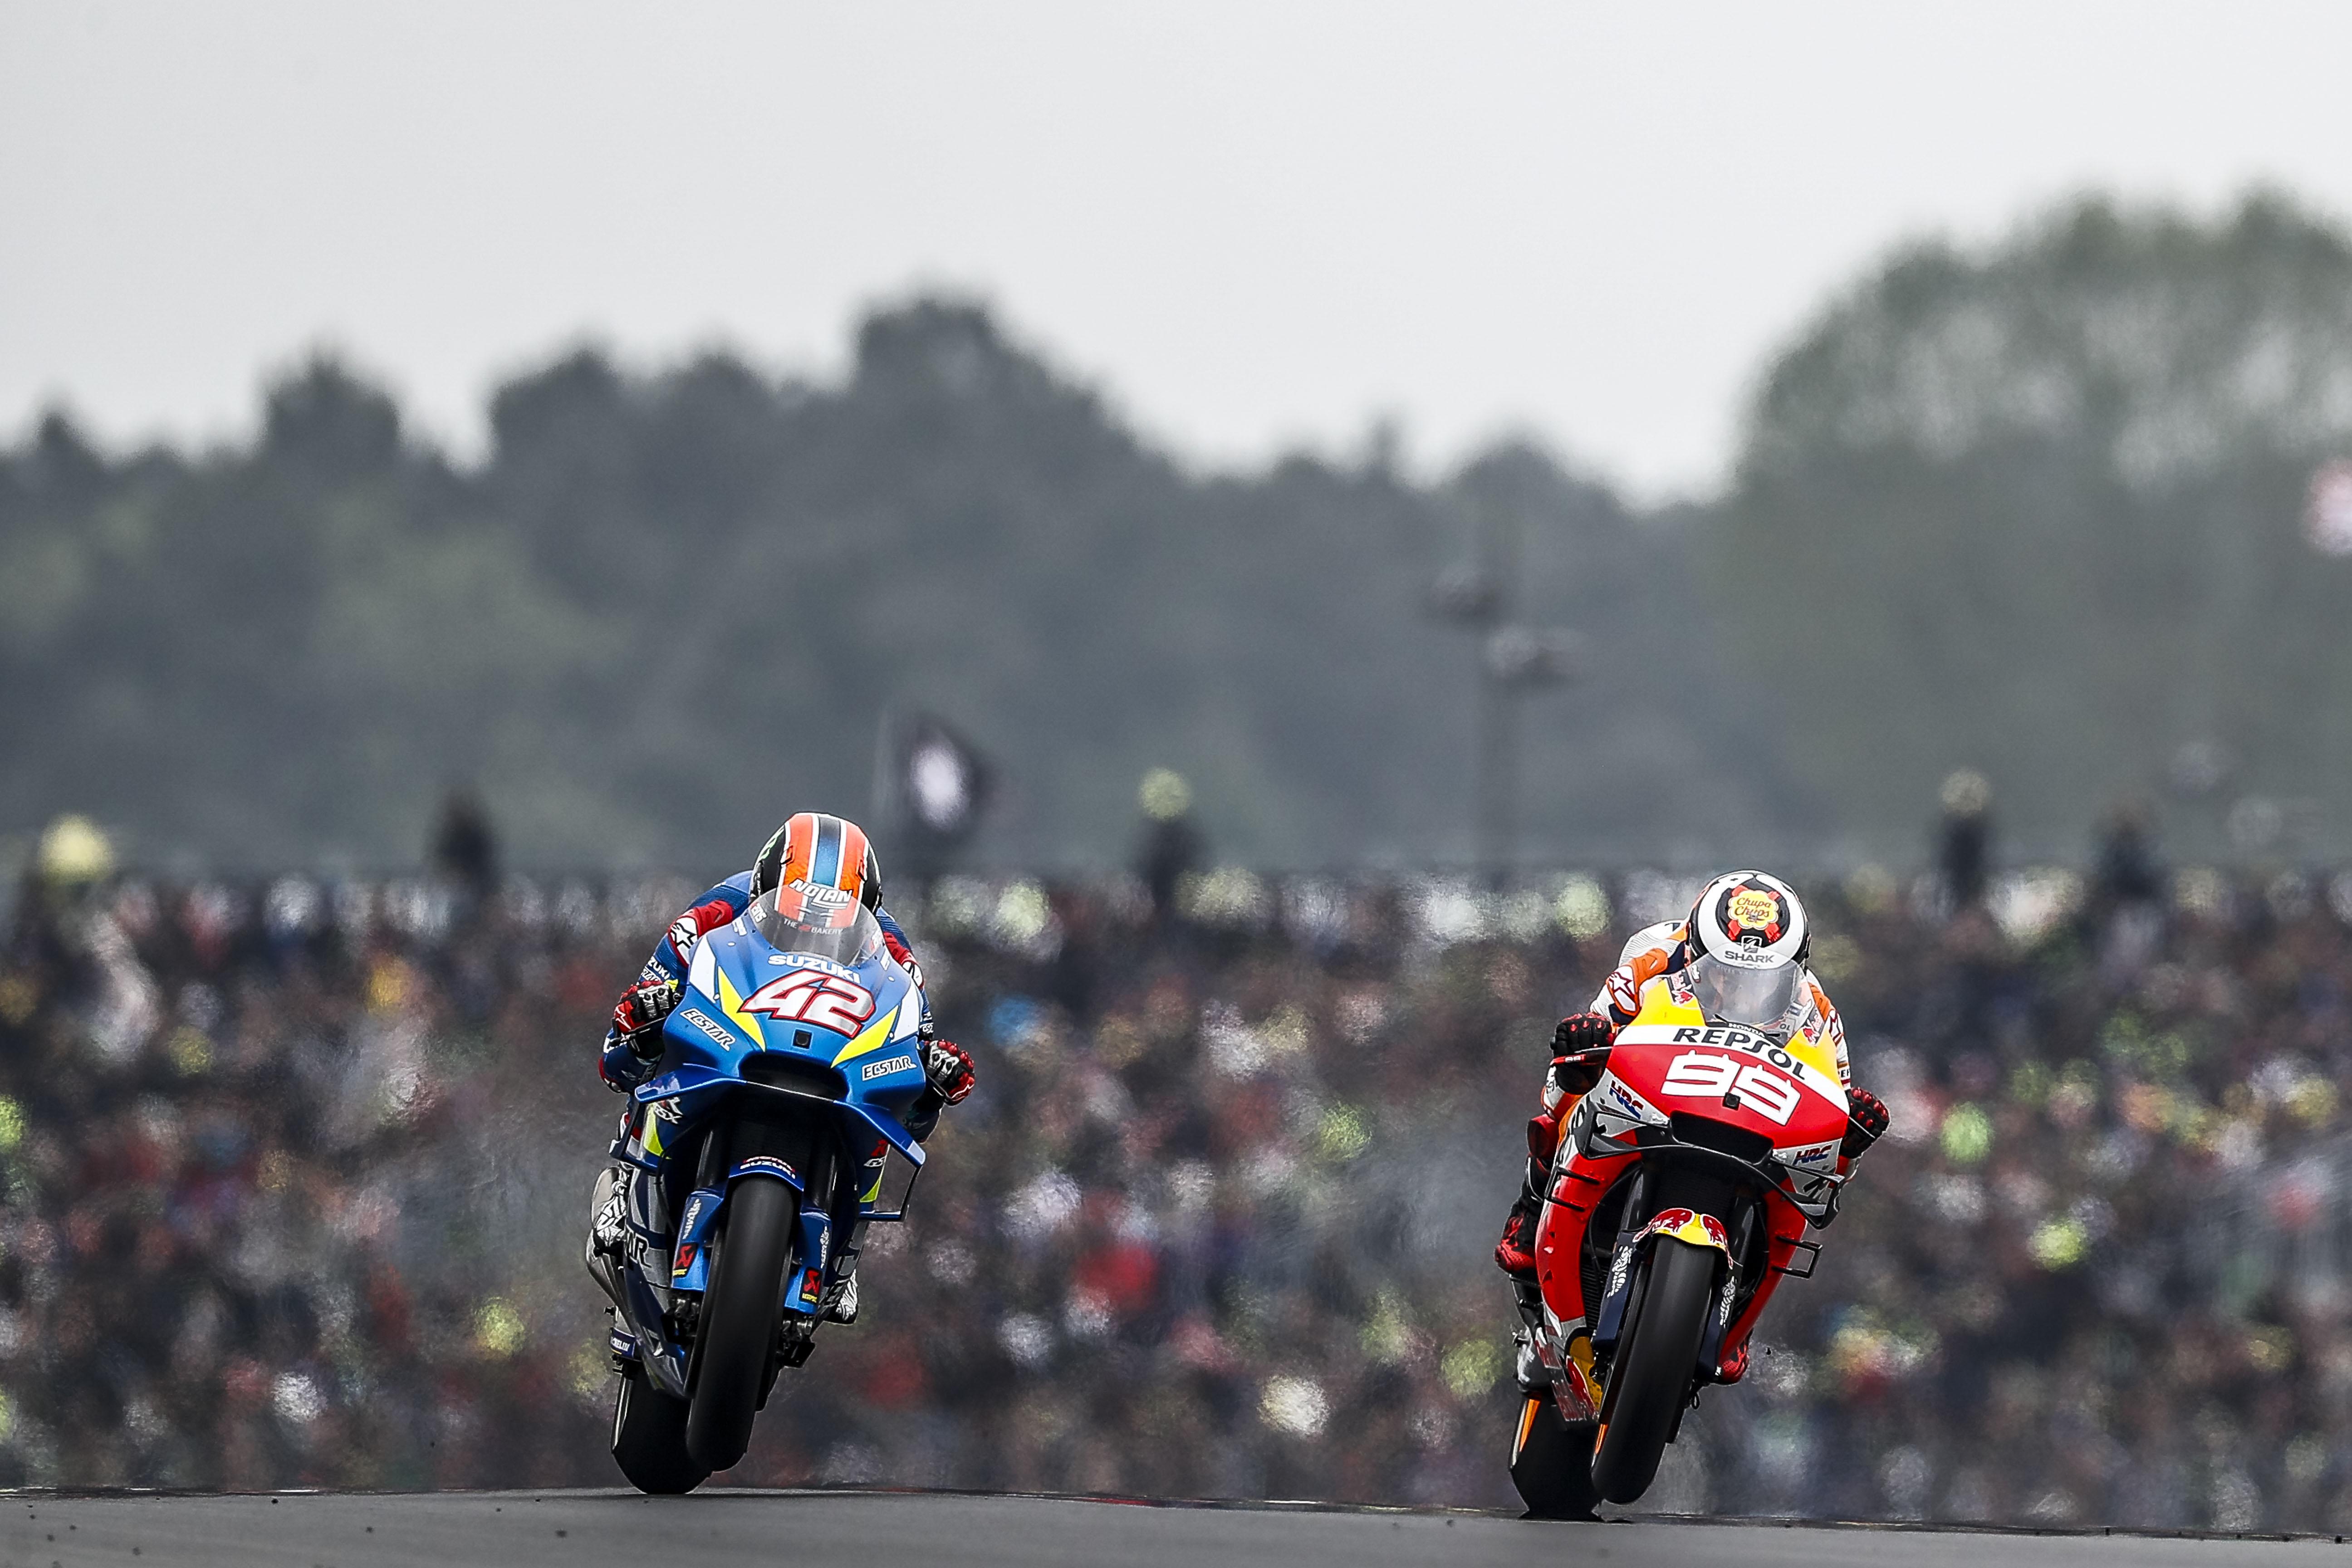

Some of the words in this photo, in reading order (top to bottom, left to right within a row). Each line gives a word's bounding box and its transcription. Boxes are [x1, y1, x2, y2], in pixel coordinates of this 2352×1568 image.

[789, 878, 853, 909] NOLAN
[1736, 897, 1772, 909] Chupa
[784, 917, 798, 929] THE
[1734, 906, 1769, 918] Chups
[647, 956, 671, 980] ZUKI
[1724, 950, 1775, 963] SHARK
[768, 954, 861, 984] SUZUKI
[738, 968, 876, 1039] 42
[681, 1008, 735, 1051] ECSTAR
[1728, 1022, 1766, 1038] HONDA
[1672, 1028, 1805, 1080] REPSOL
[862, 1056, 916, 1080] ECSTAR
[1609, 1079, 1644, 1120] HRC
[1660, 1049, 1801, 1127] 99
[1792, 1144, 1833, 1166] HRC
